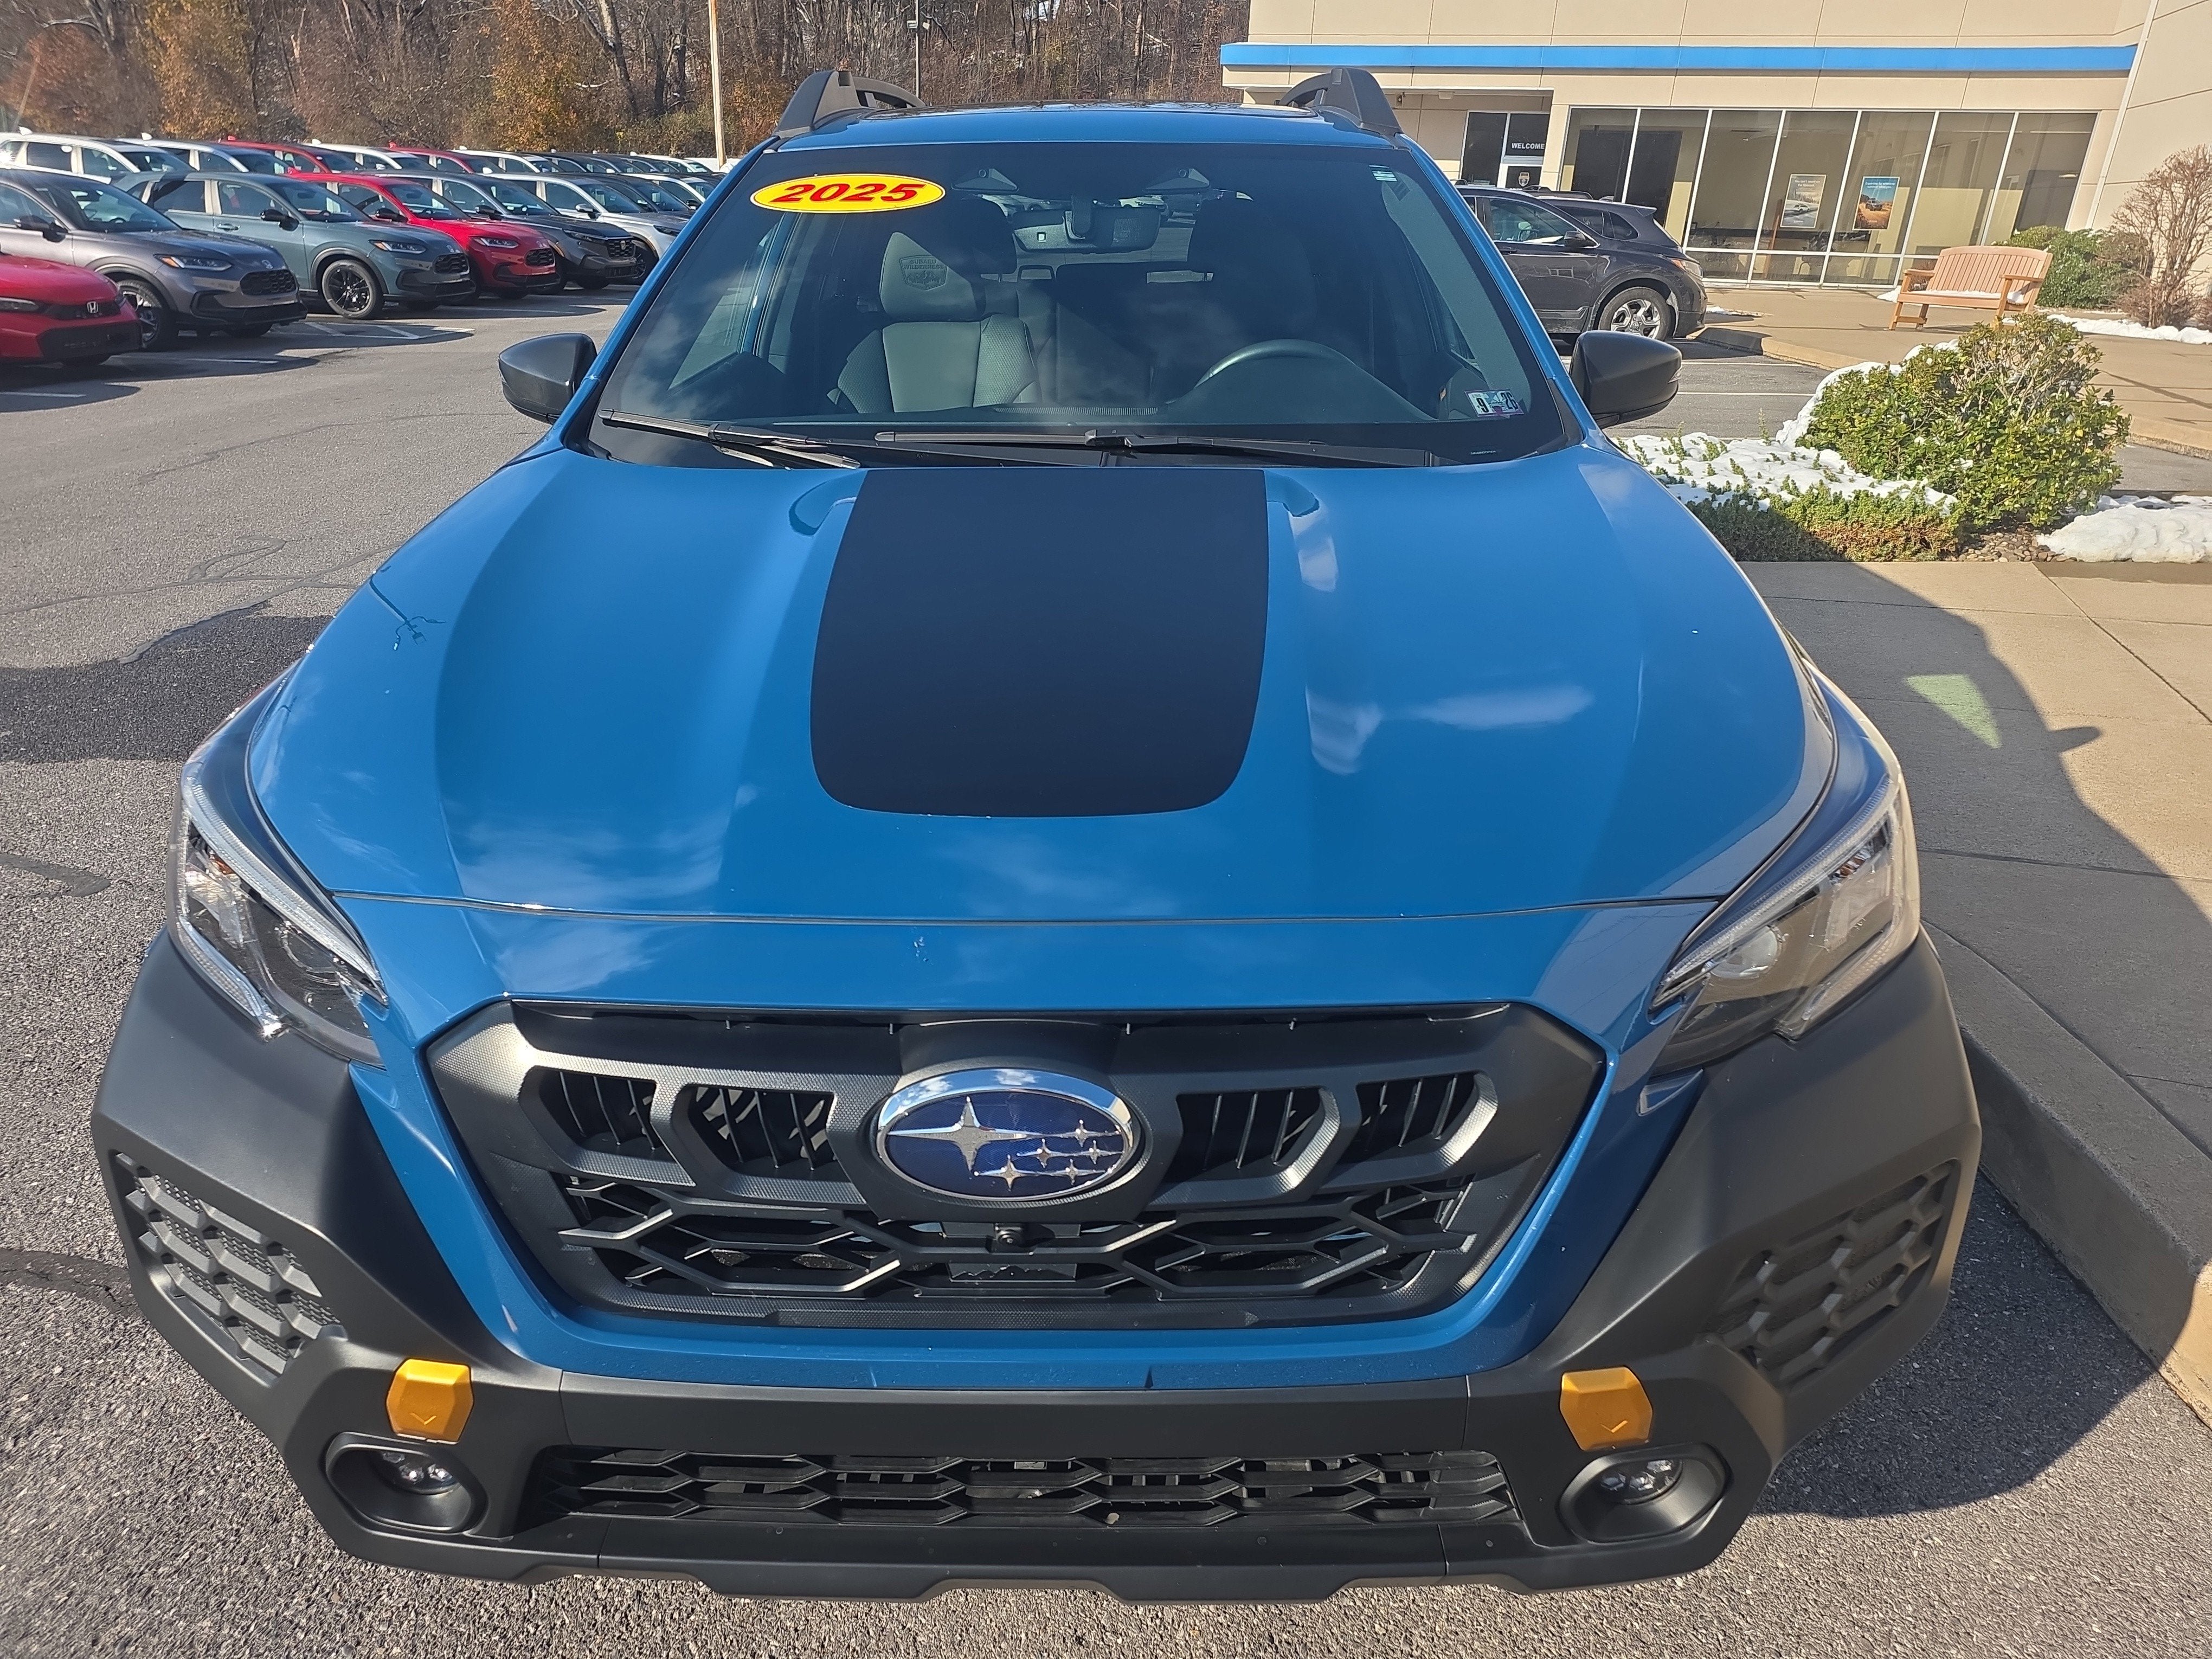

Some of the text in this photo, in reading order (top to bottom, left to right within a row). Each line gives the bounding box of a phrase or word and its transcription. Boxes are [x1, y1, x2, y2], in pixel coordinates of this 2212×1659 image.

[768, 183, 926, 203] 2025
[1476, 392, 1519, 413] 9 26
